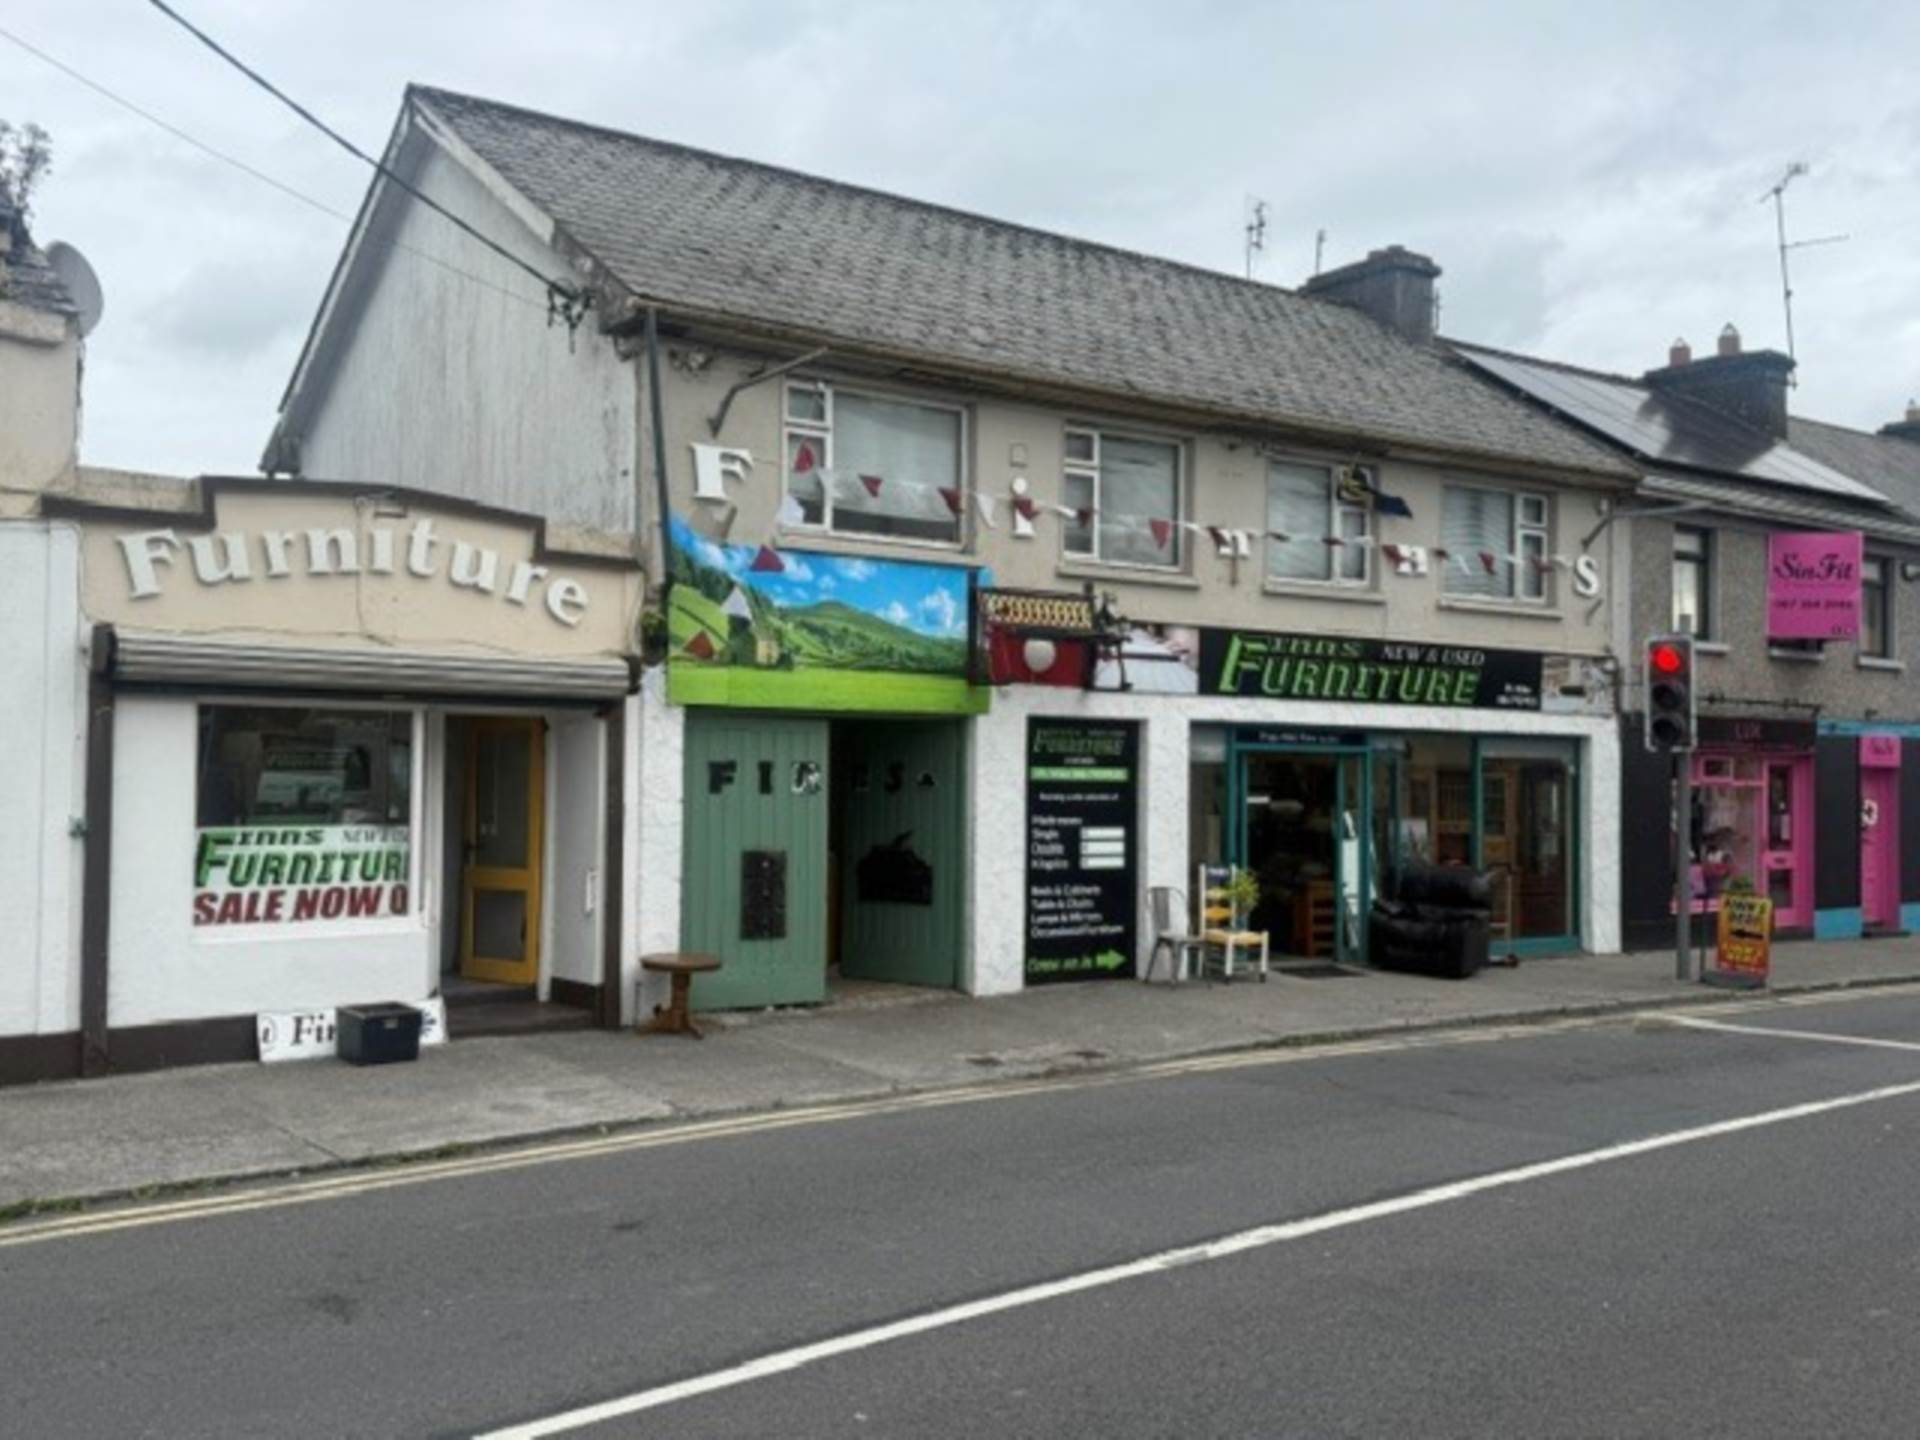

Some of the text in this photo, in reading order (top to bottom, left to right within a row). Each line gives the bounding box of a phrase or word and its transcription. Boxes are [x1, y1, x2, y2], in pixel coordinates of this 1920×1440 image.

[117, 517, 590, 626] Furniture
[195, 830, 409, 888] FURNITUR
[194, 890, 287, 926] SALE
[290, 887, 382, 920] NOW
